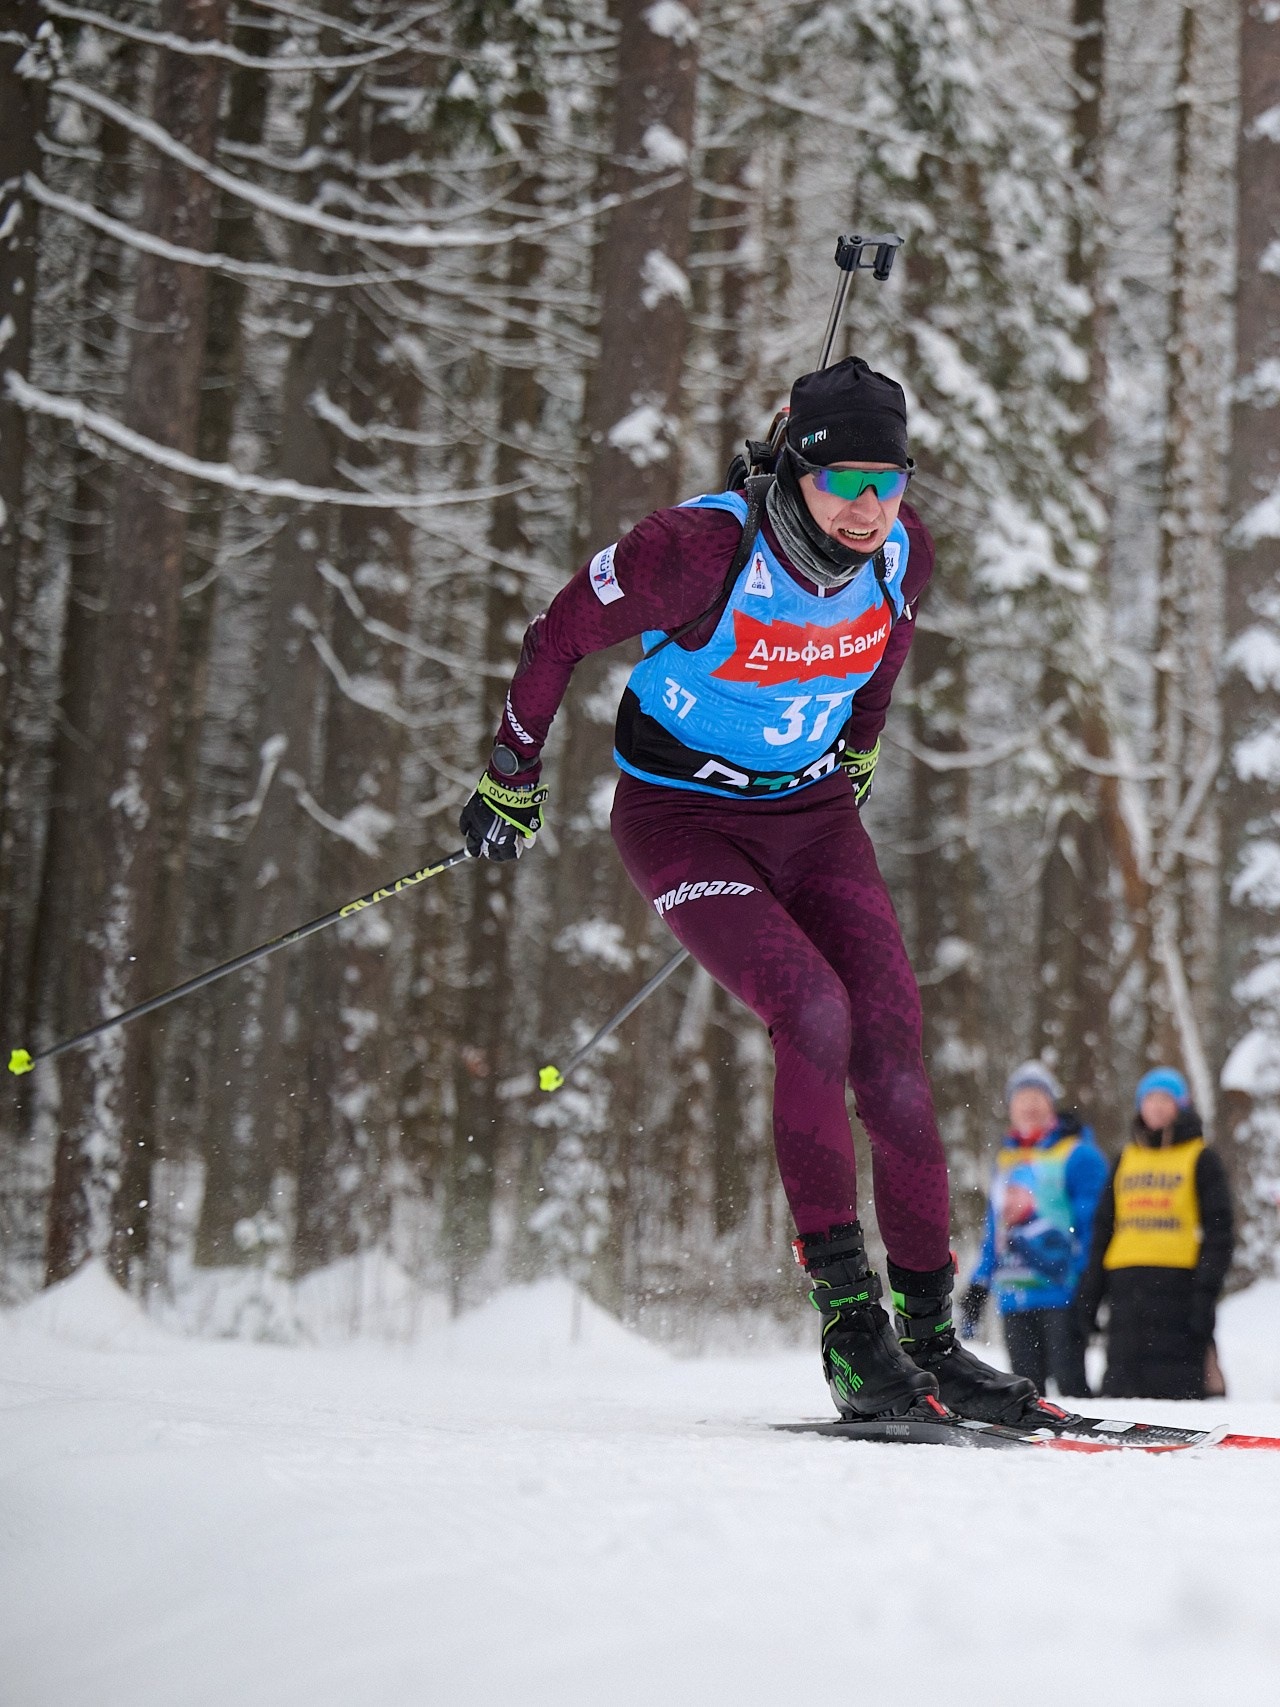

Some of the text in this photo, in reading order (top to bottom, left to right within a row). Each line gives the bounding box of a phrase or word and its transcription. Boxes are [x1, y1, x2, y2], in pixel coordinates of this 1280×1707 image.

[748, 624, 886, 666] Альфа Банк
[661, 676, 697, 720] 37
[763, 690, 853, 746] 37
[829, 1291, 870, 1308] SPINE
[934, 1318, 953, 1333] SPI
[829, 1347, 864, 1392] SPINE
[886, 1424, 910, 1436] ATOMIC
